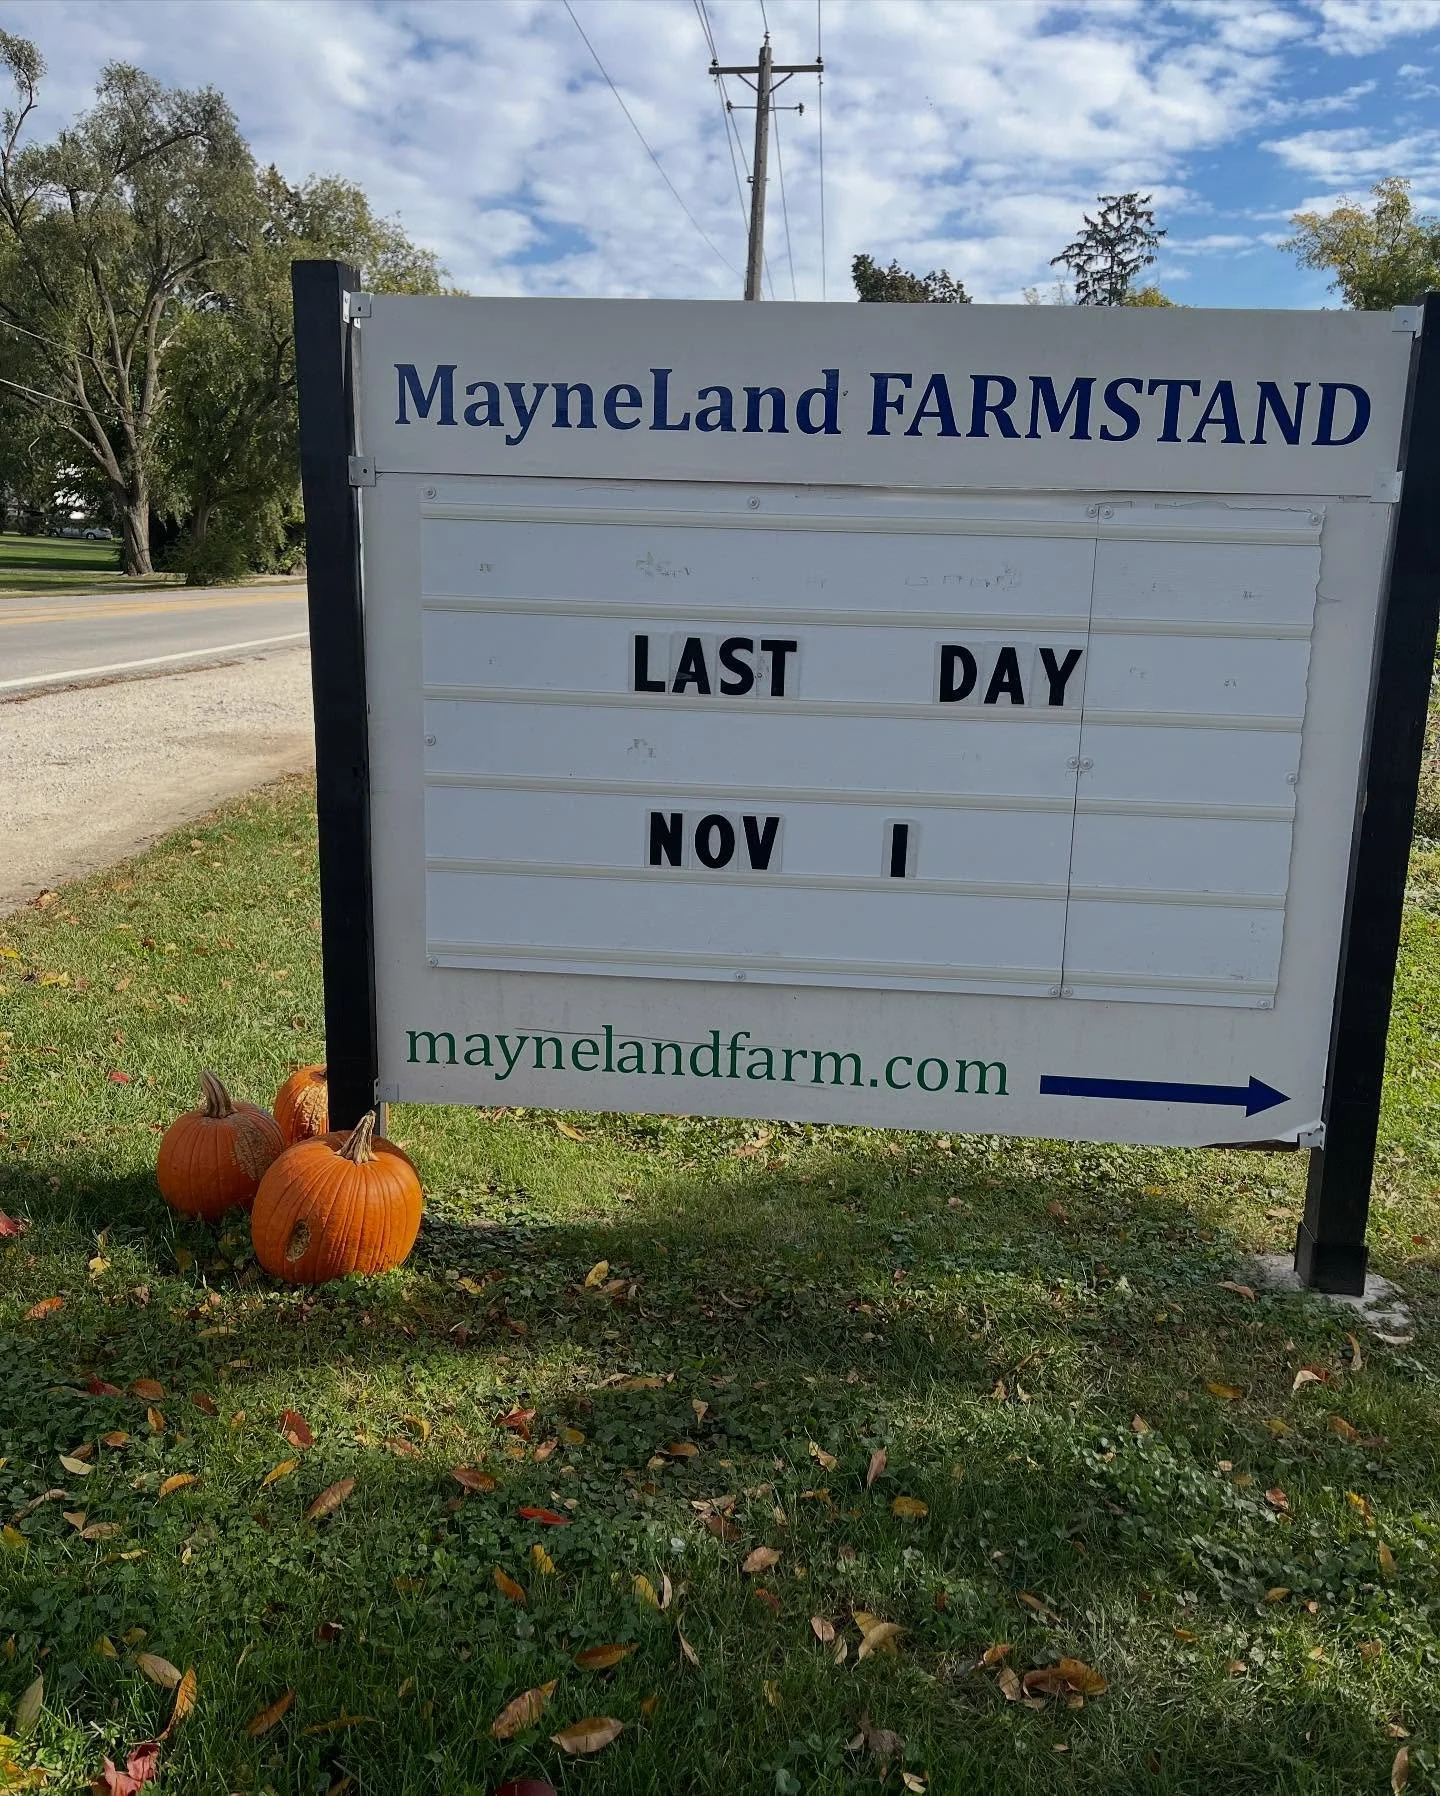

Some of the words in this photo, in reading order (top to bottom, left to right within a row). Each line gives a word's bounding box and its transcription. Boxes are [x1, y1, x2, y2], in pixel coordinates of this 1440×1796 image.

[394, 364, 843, 445] MayneLand
[866, 373, 1371, 446] FARMSTAND
[635, 635, 798, 697] LAST
[940, 645, 1084, 706] DAY
[650, 811, 780, 870] NOV
[406, 1024, 1009, 1096] maynelandfarm.com
